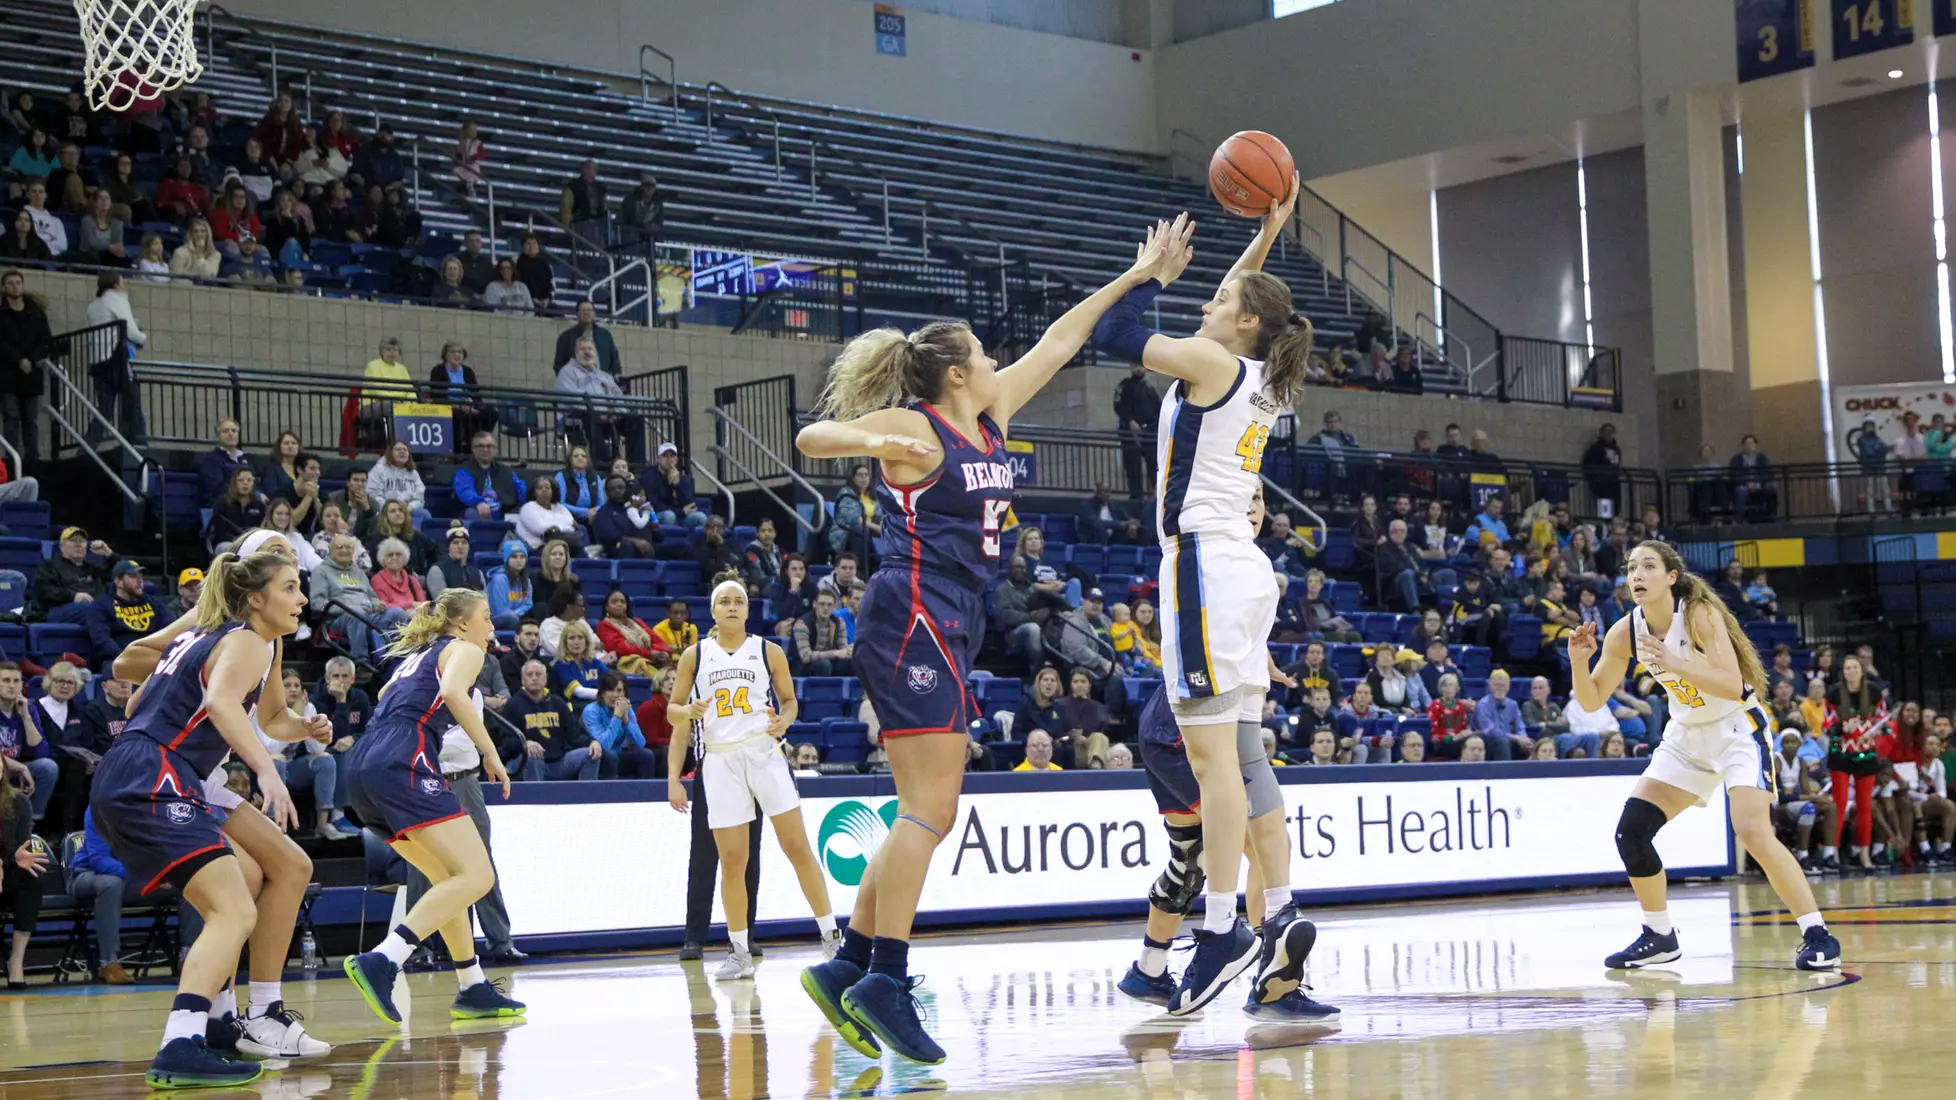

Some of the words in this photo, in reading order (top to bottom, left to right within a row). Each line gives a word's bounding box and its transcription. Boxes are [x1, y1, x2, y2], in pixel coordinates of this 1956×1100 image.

[879, 15, 901, 32] 205
[1843, 0, 1884, 41] 14
[1758, 25, 1779, 62] 3
[1845, 396, 1901, 412] CHUCK
[407, 422, 443, 446] 103
[1008, 457, 1028, 478] 04
[154, 630, 206, 676] 31
[709, 668, 755, 687] MARQUETTE
[715, 686, 753, 717] 24
[951, 805, 1151, 876] Aurora
